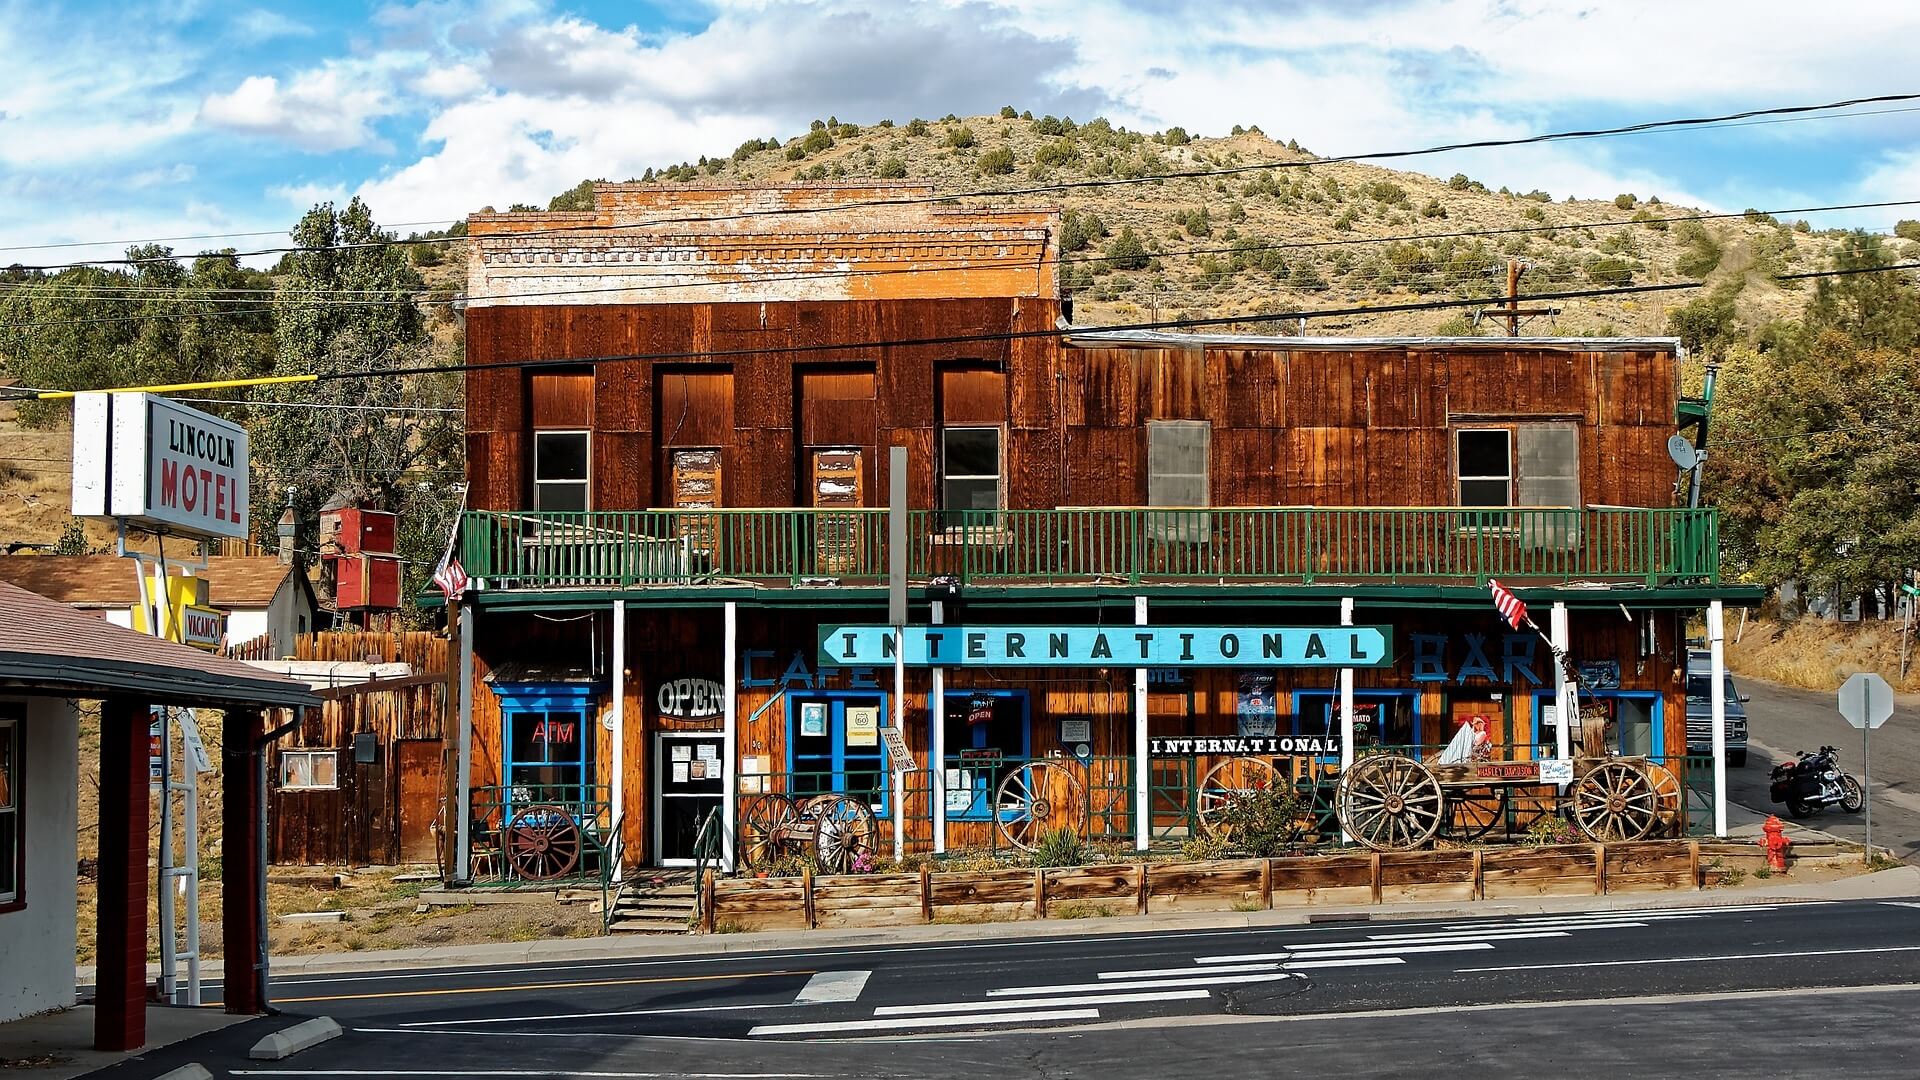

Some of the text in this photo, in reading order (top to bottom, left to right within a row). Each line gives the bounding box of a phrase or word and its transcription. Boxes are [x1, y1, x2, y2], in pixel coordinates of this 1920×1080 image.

[169, 419, 235, 468] LINCOLN
[161, 458, 241, 524] MOTEL
[187, 615, 219, 637] VACANCY
[842, 633, 1367, 660] INTERNATIONAL
[1409, 632, 1543, 686] BAR
[1147, 668, 1184, 683] OTEL
[658, 679, 725, 717] OPEN
[968, 711, 992, 722] OPEN
[531, 721, 574, 743] ATM
[884, 733, 902, 745] FREE
[890, 745, 907, 757] REST
[1151, 738, 1338, 753] INTERNATIONAL
